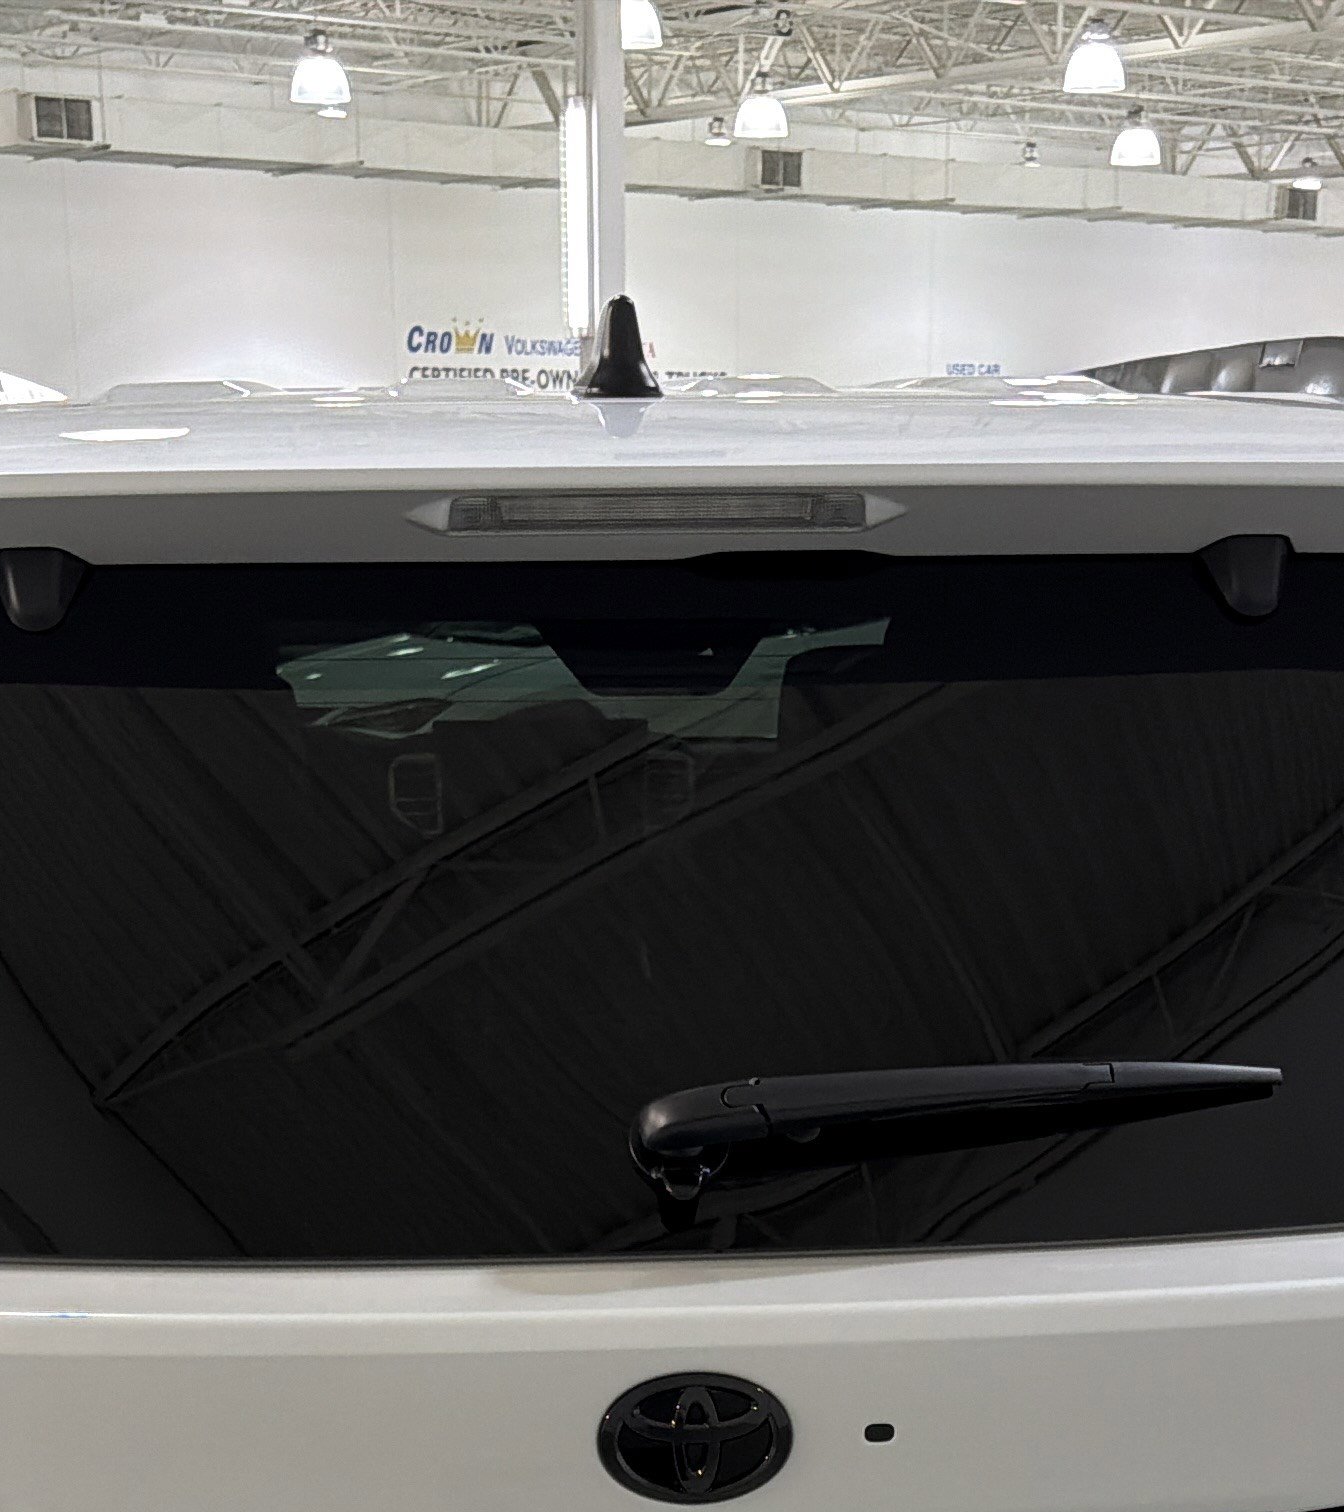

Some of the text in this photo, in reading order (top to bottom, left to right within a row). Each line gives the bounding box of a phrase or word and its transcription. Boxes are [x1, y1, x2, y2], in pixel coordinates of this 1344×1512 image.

[407, 317, 580, 357] CROWN VOLKSWAGE
[977, 363, 1001, 376] CAR
